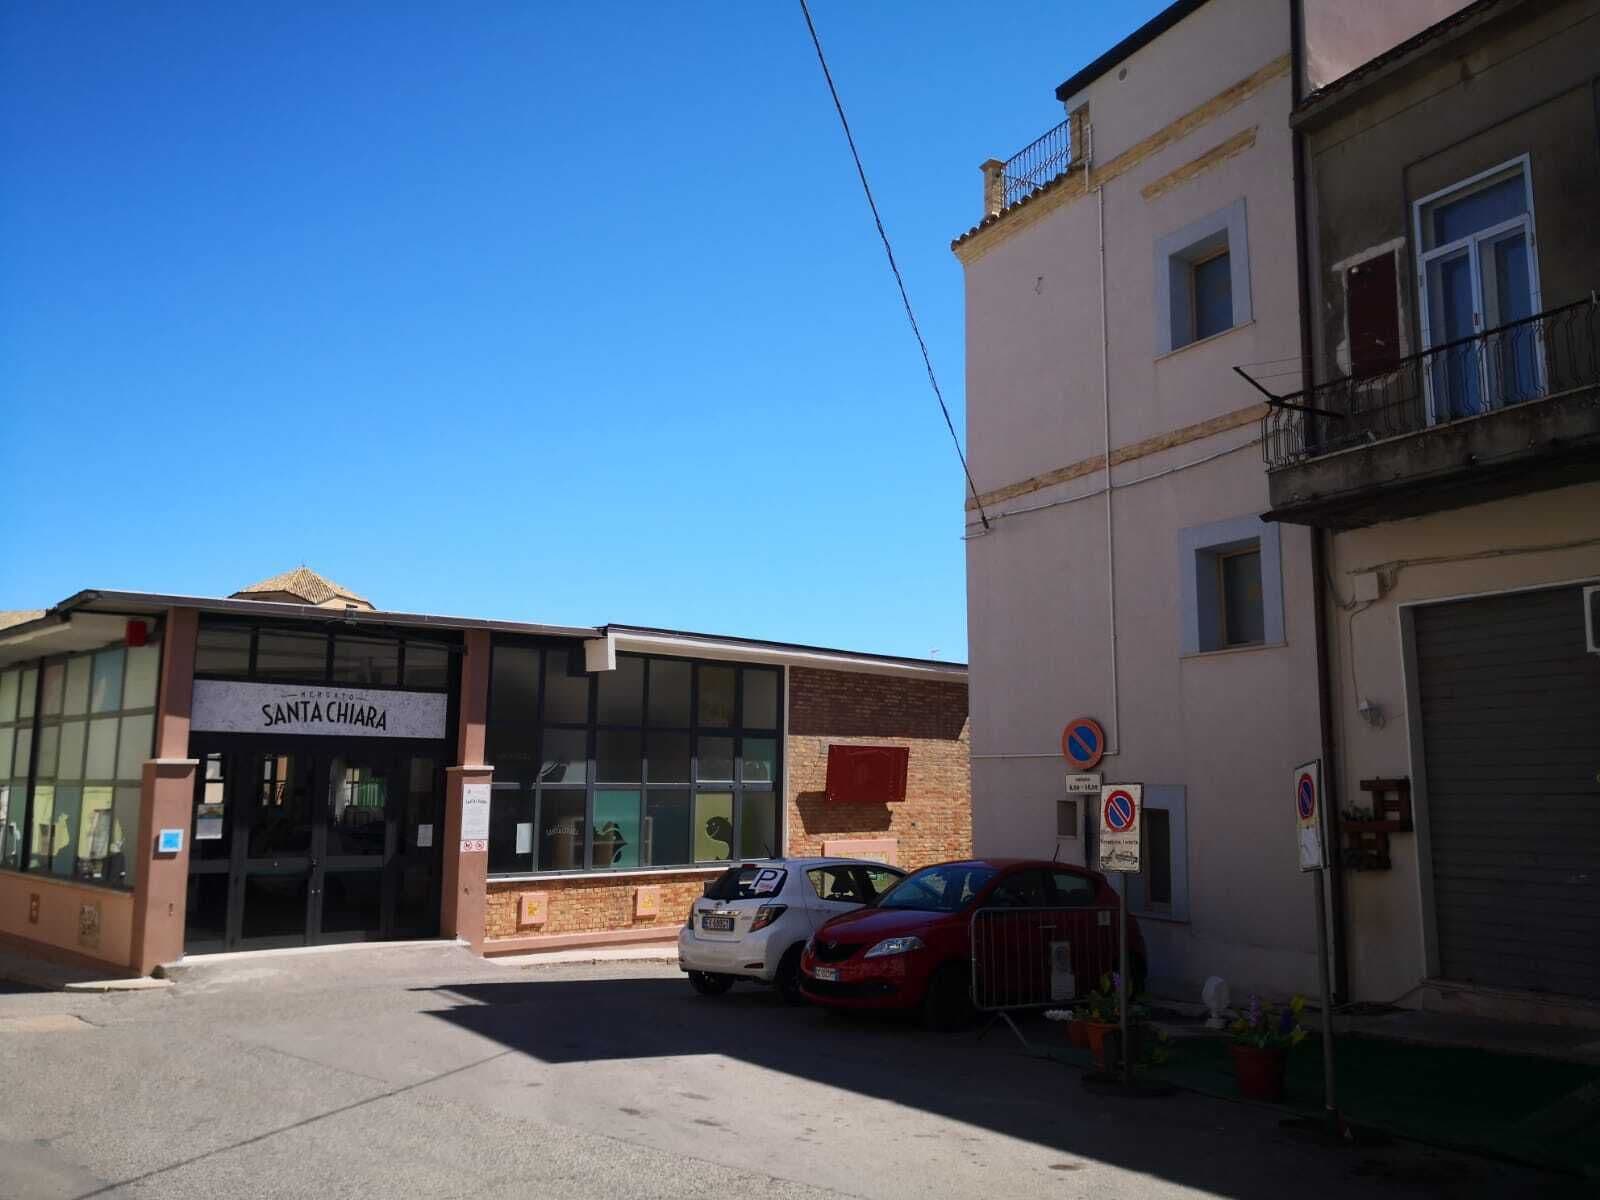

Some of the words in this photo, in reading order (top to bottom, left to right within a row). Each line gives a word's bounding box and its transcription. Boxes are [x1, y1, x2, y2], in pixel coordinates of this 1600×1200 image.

[261, 700, 323, 727] SANTA
[326, 701, 387, 731] CHIARA
[753, 869, 778, 888] P
